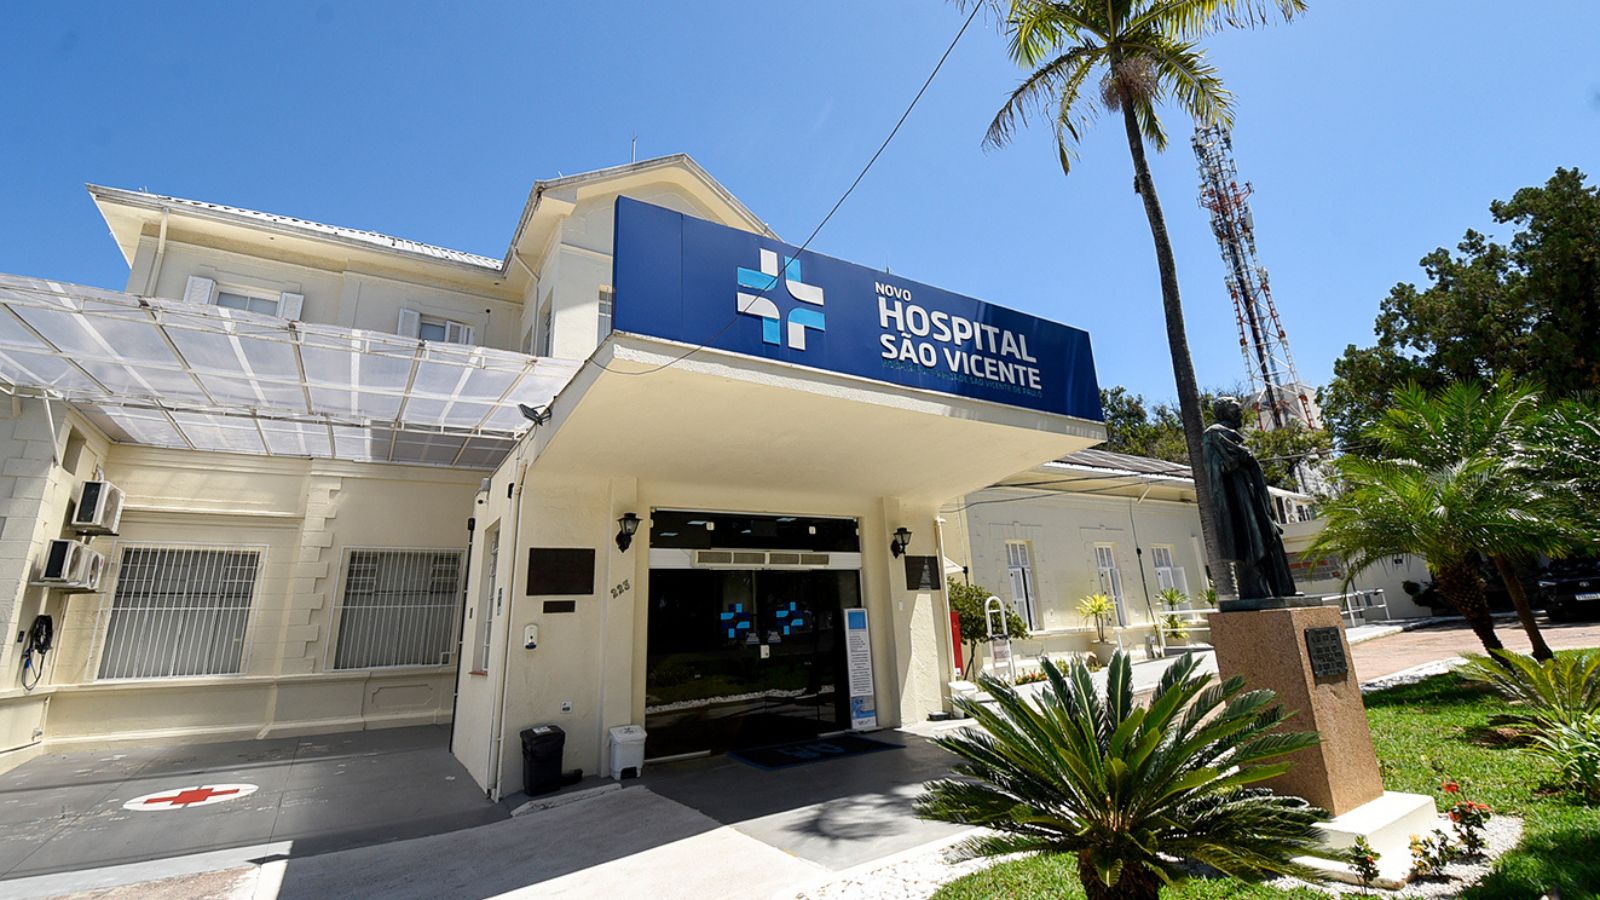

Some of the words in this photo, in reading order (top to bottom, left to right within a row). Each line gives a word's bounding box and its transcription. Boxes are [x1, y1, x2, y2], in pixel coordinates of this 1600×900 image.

[875, 282, 912, 301] NOVO
[878, 296, 1037, 363] HOSPITAL
[880, 333, 937, 368] SÃO
[943, 347, 1042, 390] VICENTE
